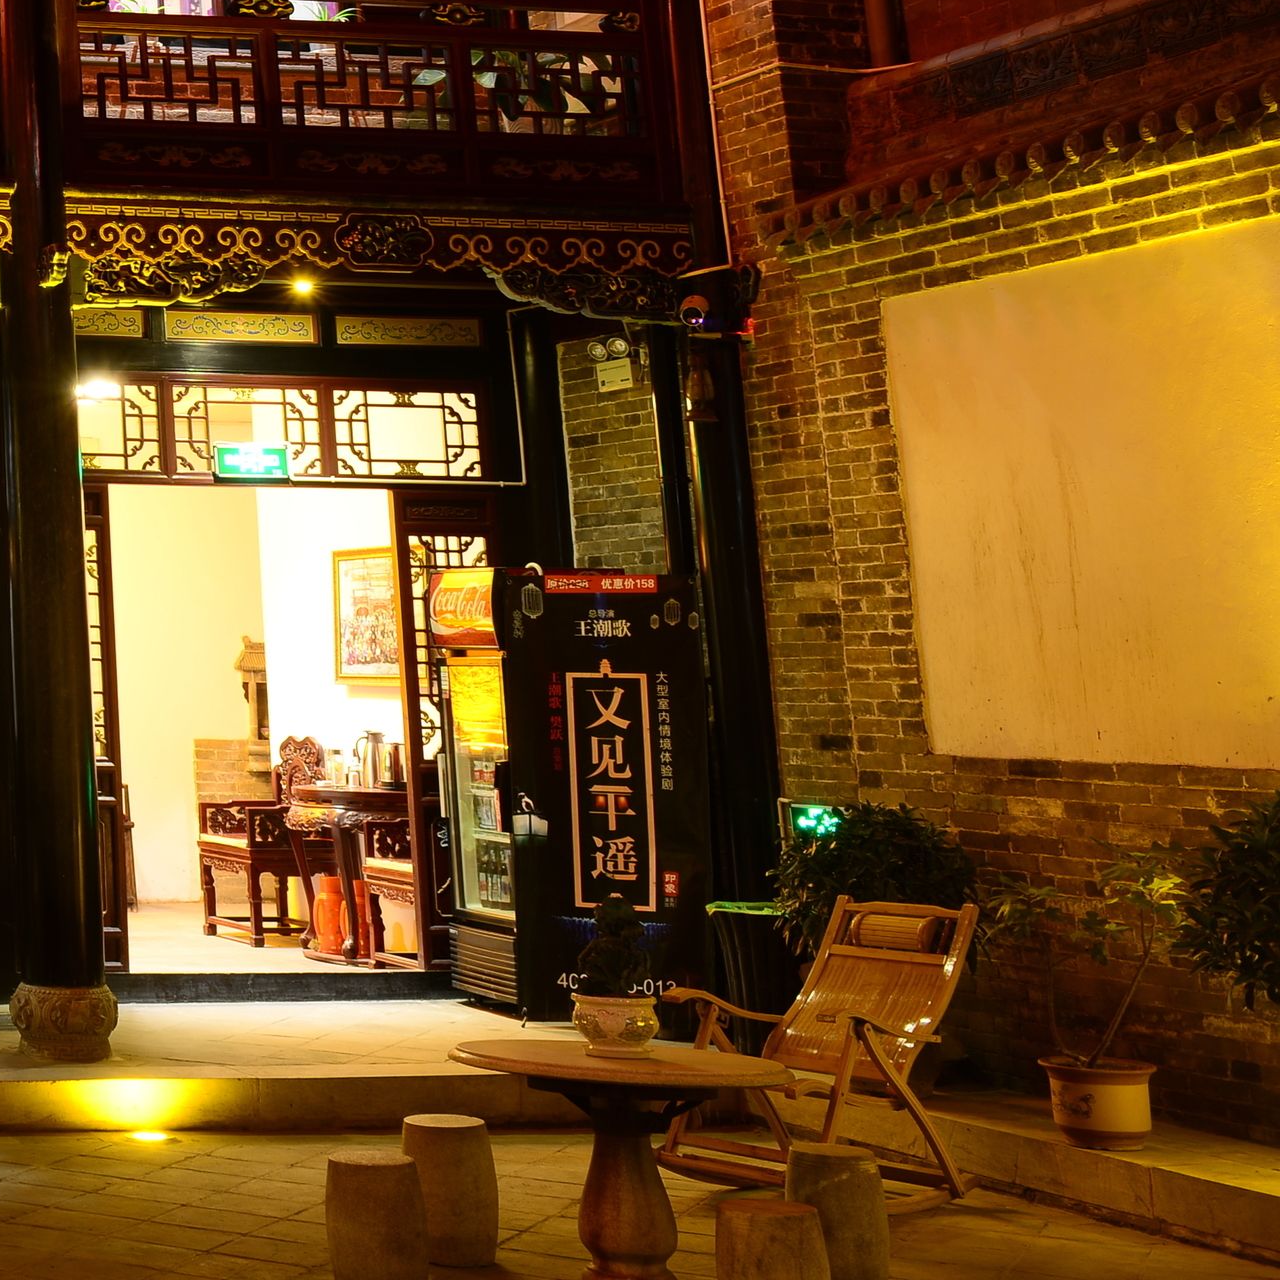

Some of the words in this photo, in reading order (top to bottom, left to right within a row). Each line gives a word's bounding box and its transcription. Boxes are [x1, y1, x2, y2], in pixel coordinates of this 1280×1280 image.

[601, 578, 655, 589] 优惠价158
[588, 609, 615, 618] 总导演
[574, 619, 631, 638] 王潮歌
[655, 671, 674, 791] 大型室内情境体验剧
[584, 685, 639, 882] 又见平遥
[664, 873, 678, 894] 印象
